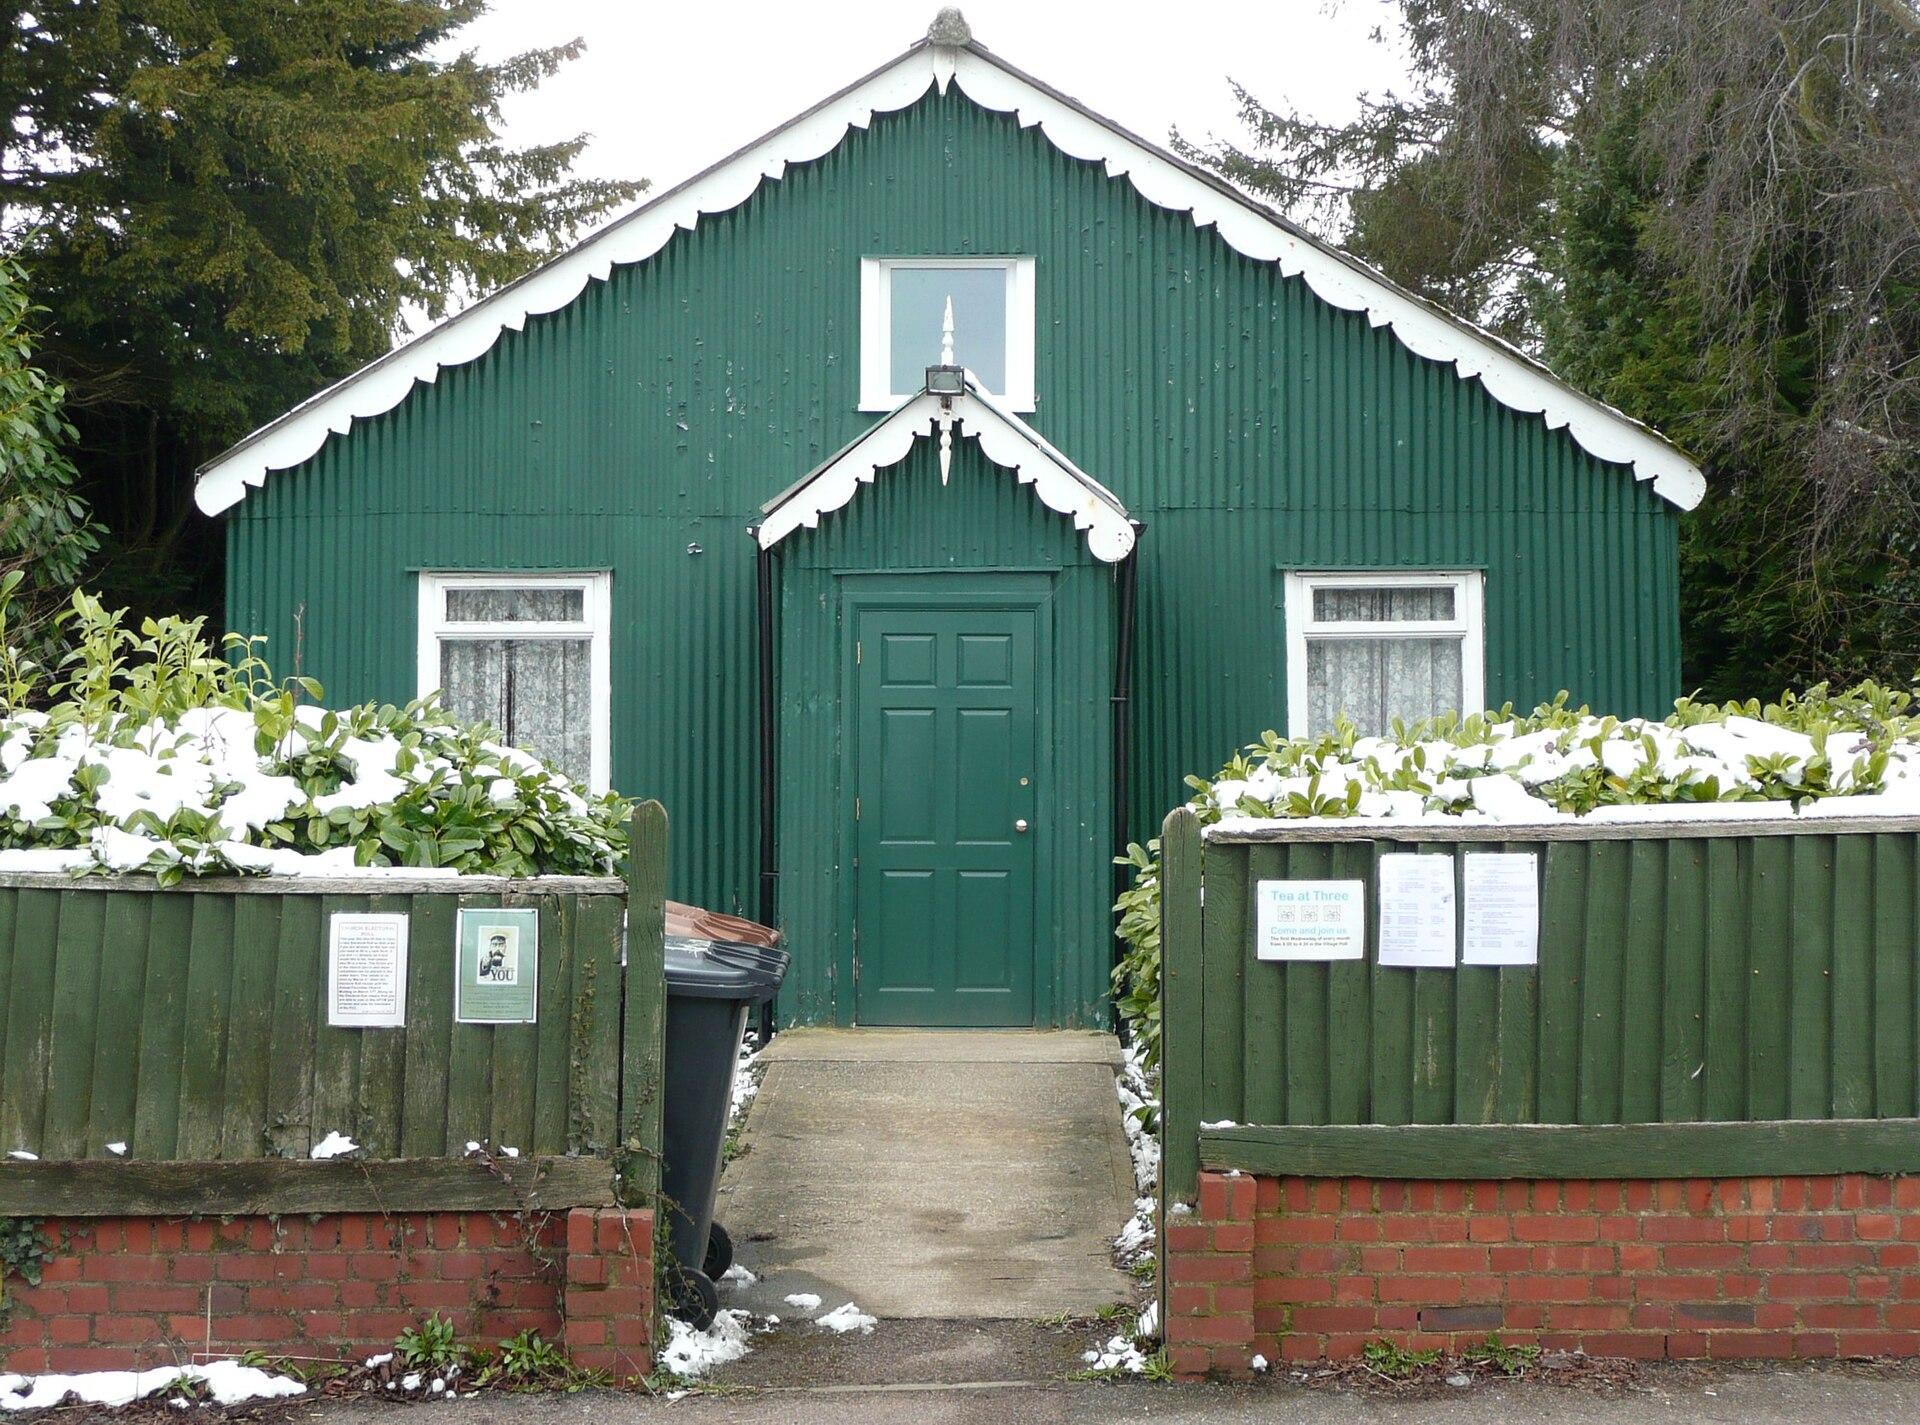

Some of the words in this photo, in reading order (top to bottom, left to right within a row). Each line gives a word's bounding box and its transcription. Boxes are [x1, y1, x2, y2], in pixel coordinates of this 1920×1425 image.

[1271, 891, 1294, 901] Tea
[1297, 891, 1310, 901] at
[1313, 891, 1349, 901] Three
[1270, 927, 1298, 935] Come
[1299, 926, 1317, 935] and
[1318, 926, 1334, 936] join
[490, 969, 515, 981] YOU
